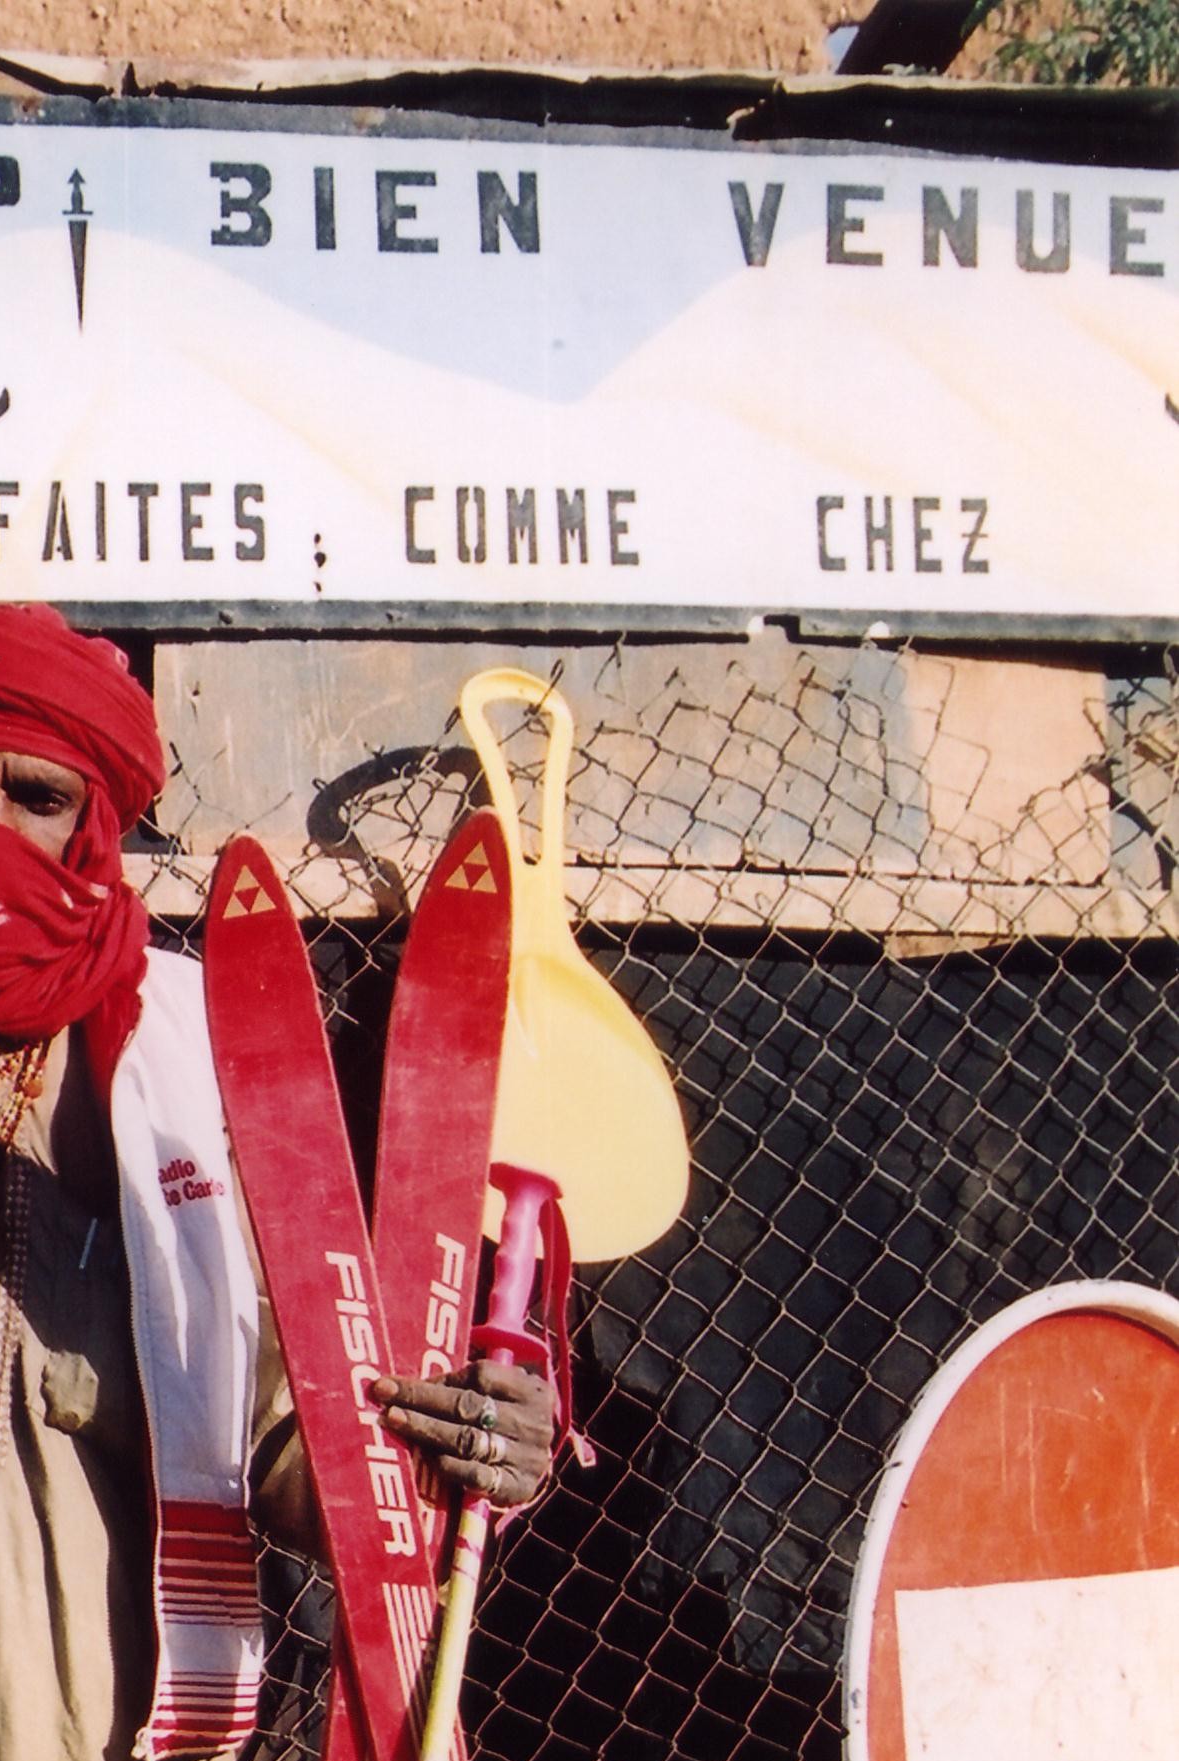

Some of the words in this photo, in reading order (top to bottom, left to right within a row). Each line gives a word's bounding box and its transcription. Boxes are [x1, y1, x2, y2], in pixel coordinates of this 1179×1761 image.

[209, 161, 541, 254] BIEN
[727, 181, 1166, 277] VENUE
[404, 486, 640, 566] COMME
[816, 495, 991, 574] CHEZ
[183, 1178, 225, 1201] Caro
[325, 1250, 418, 1558] FISCHER
